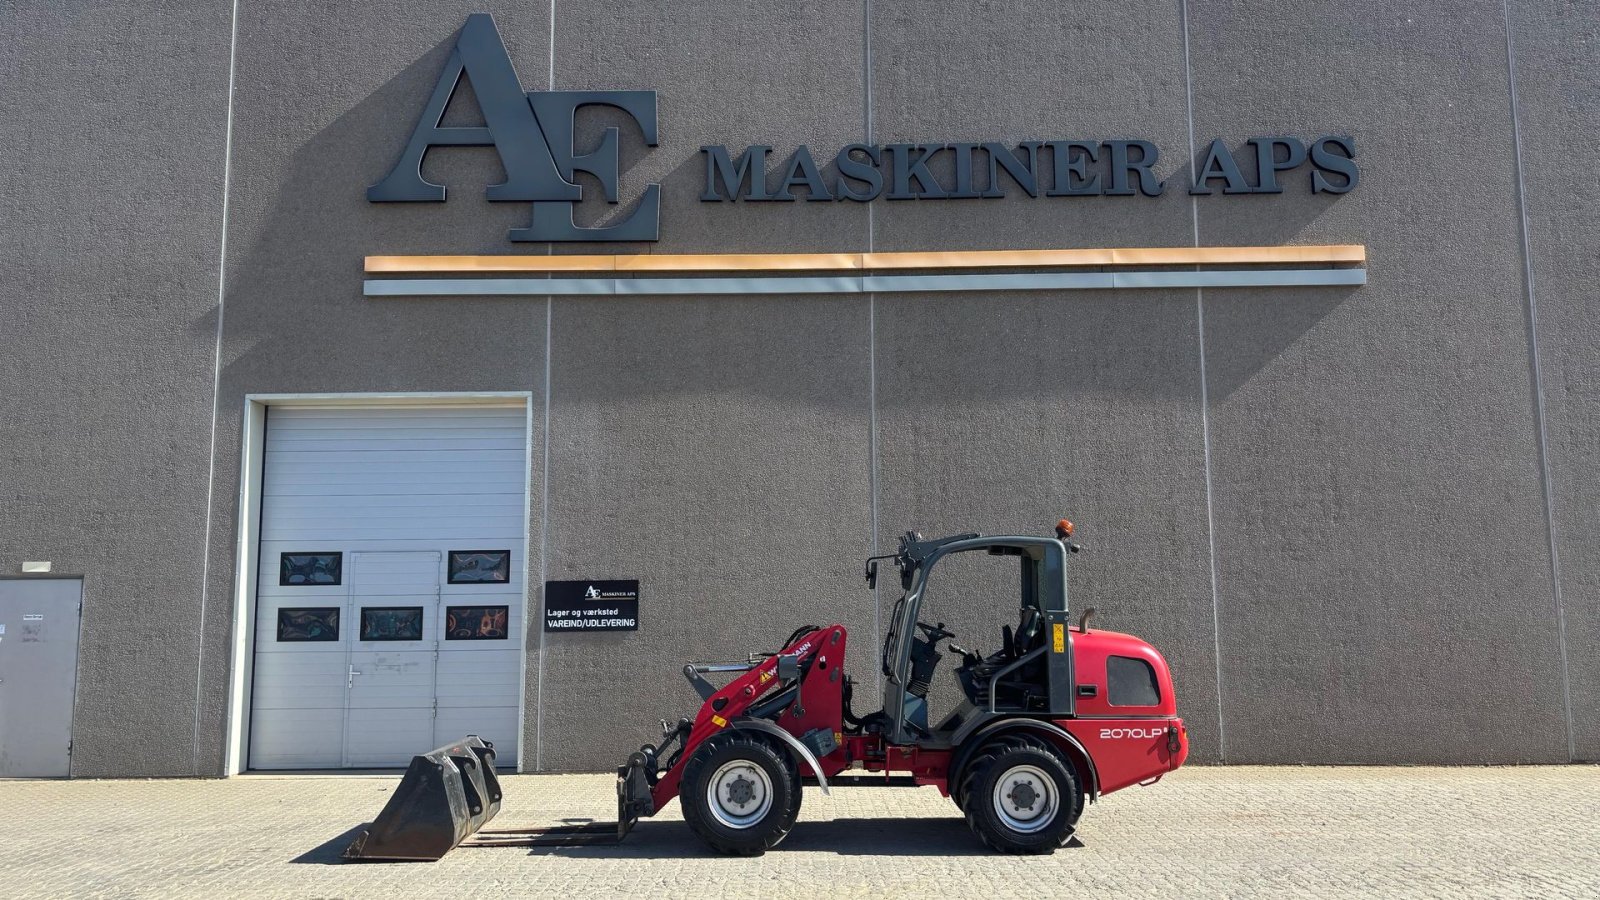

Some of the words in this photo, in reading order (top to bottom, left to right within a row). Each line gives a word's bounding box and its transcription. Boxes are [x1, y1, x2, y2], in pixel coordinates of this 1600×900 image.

[366, 12, 661, 243] AE
[700, 139, 1164, 202] MASKINER
[1189, 134, 1360, 195] APS
[547, 609, 569, 617] Lager
[583, 608, 618, 616] værksted
[548, 618, 635, 628] VAREIND/UDLEVERING
[1099, 727, 1163, 739] 2070LP
